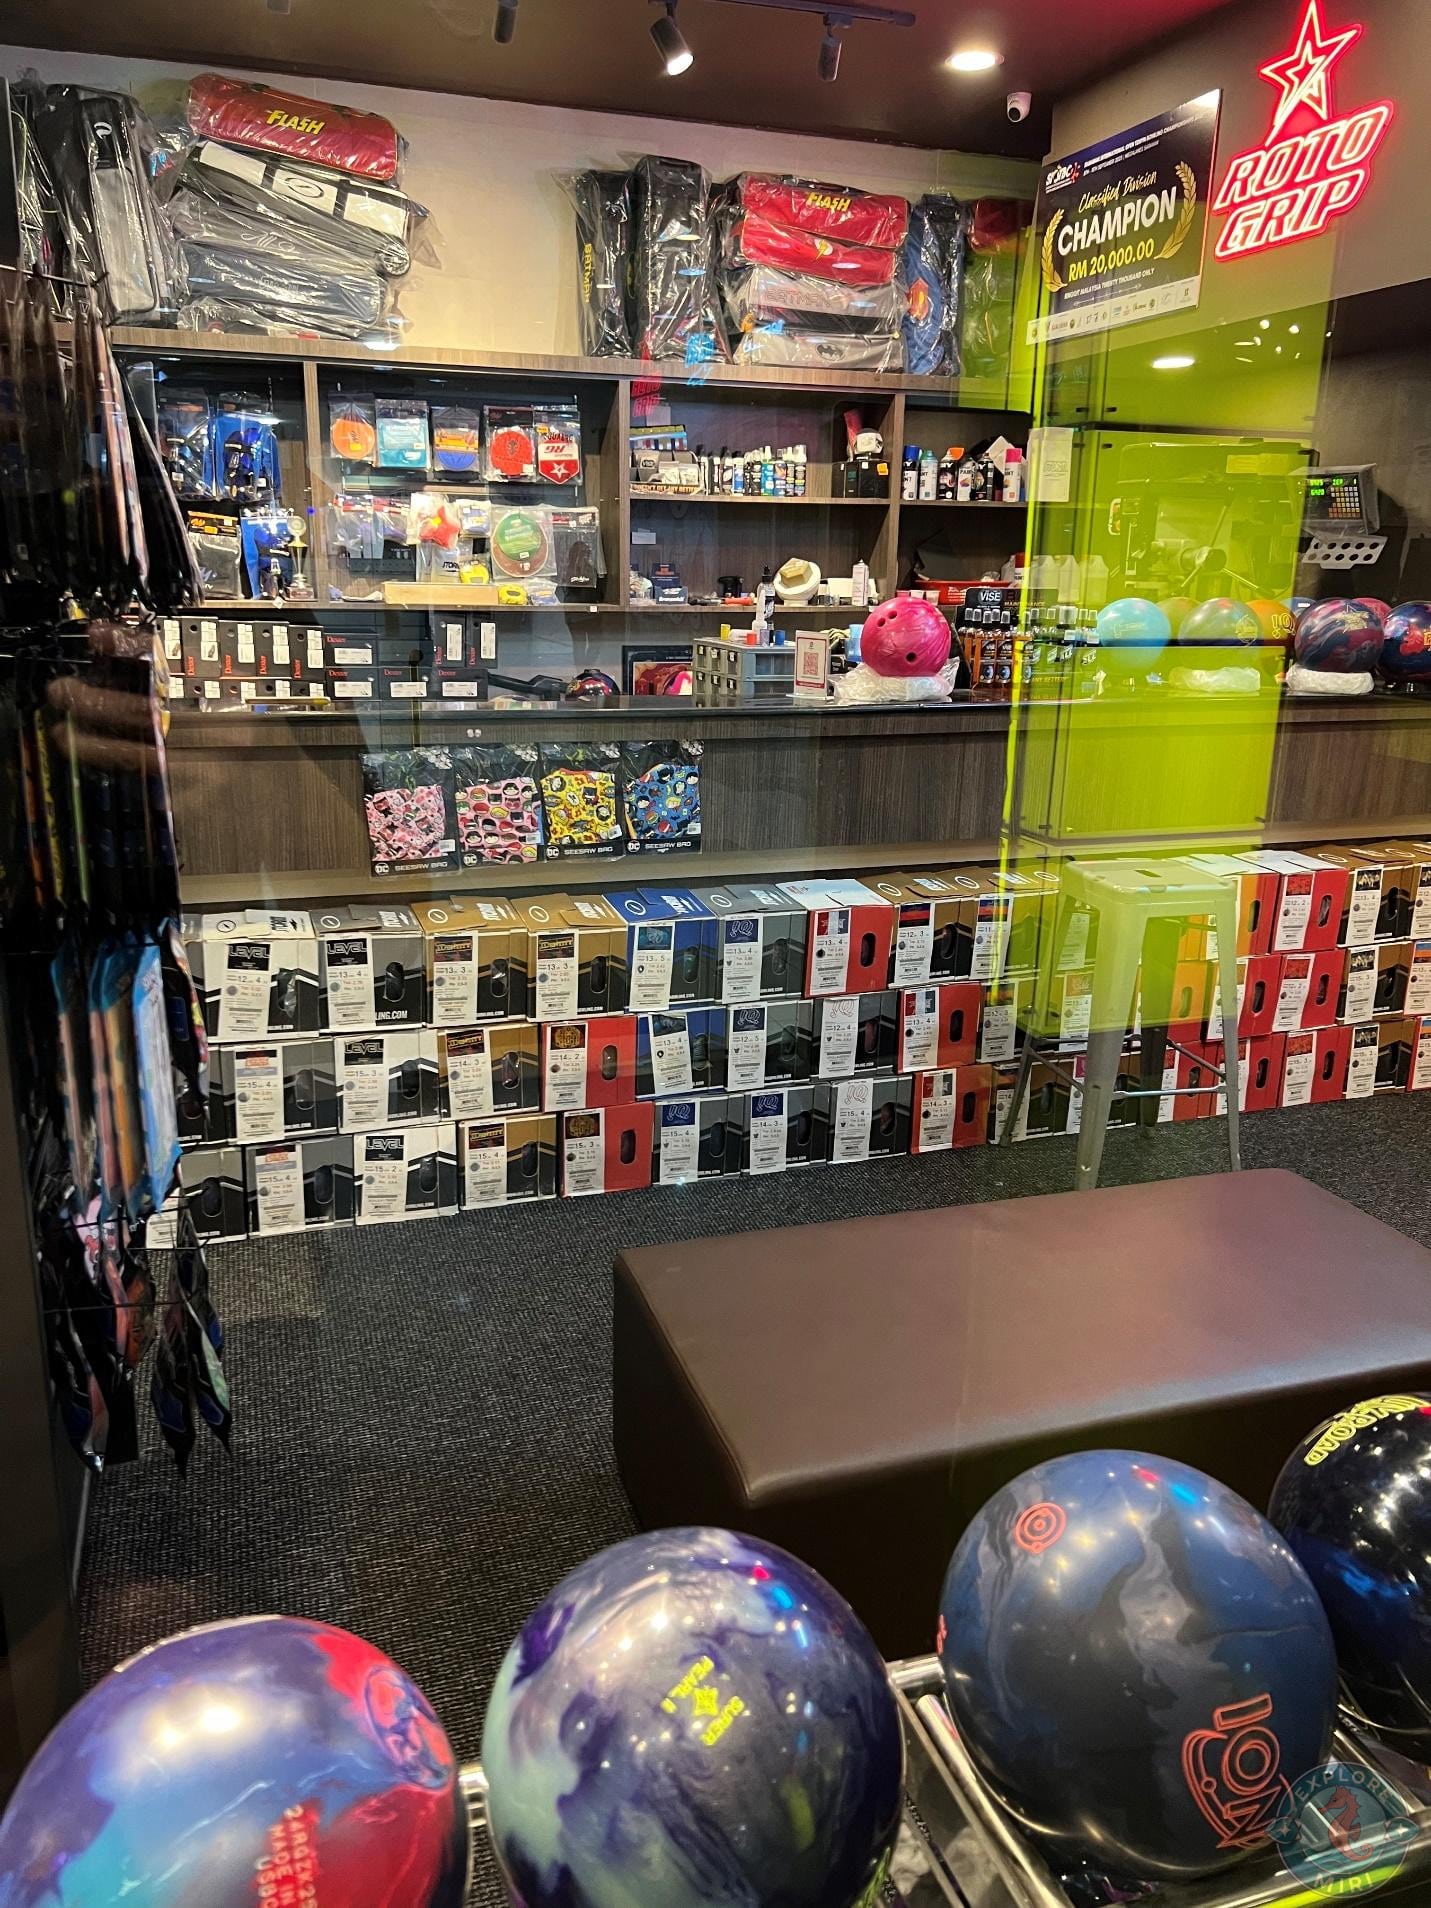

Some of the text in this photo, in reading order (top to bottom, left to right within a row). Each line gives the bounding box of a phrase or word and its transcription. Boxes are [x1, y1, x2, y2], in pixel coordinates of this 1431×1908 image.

[266, 110, 325, 135] FLASH
[1213, 105, 1389, 211] ROTO
[806, 192, 851, 212] FLASH
[1079, 181, 1121, 213] Classified
[1122, 170, 1157, 197] Division
[1058, 186, 1177, 257] CHAMPION
[1215, 169, 1365, 257] GRIP
[583, 243, 593, 304] BATMAN
[1068, 238, 1155, 283] RM 20,000.00
[1080, 284, 1101, 296] MALAYSIA
[980, 591, 1001, 601] VISE
[294, 659, 302, 679] Dexter
[329, 669, 348, 677] Dexter
[394, 863, 430, 871] SEESAW
[268, 1823, 293, 1880] MADE
